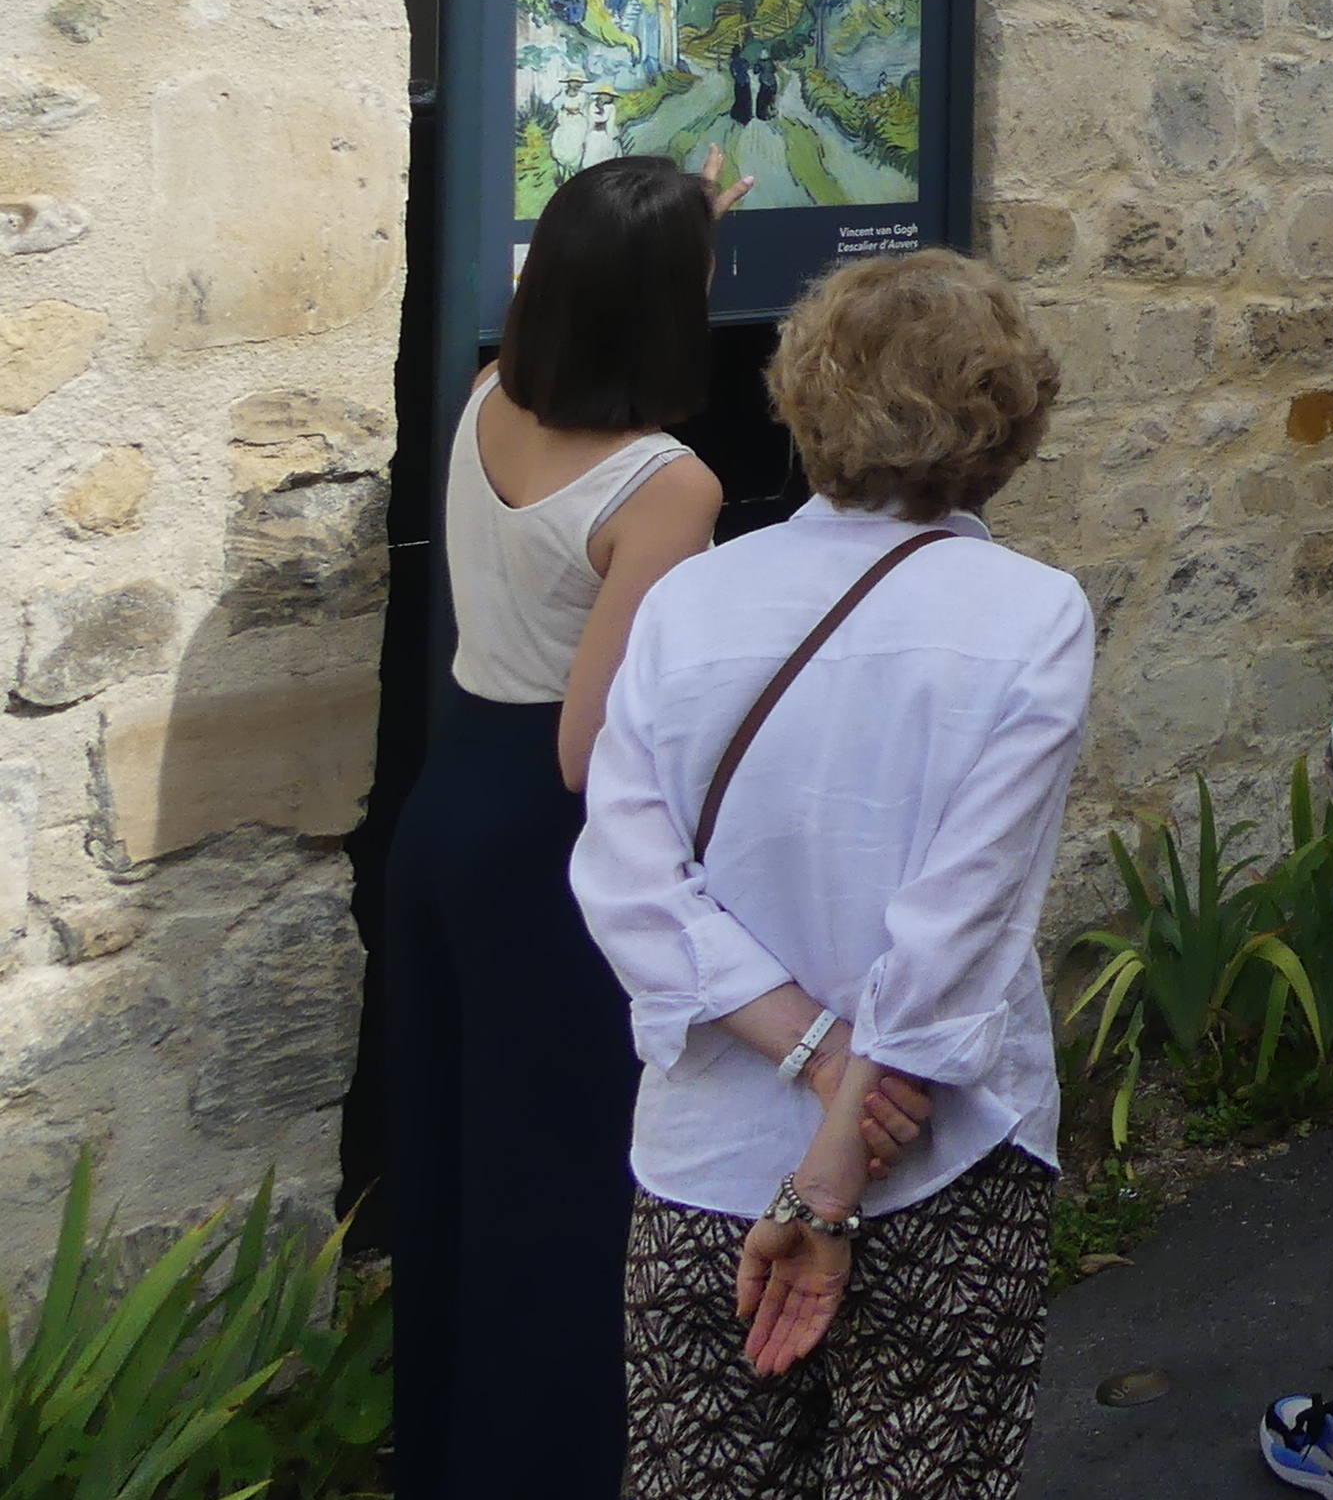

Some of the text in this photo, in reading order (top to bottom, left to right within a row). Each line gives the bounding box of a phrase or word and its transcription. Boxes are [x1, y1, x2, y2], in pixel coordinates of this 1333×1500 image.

[839, 223, 918, 237] Vincent van Gogh
[838, 239, 918, 252] L'escalier d'Auvers
